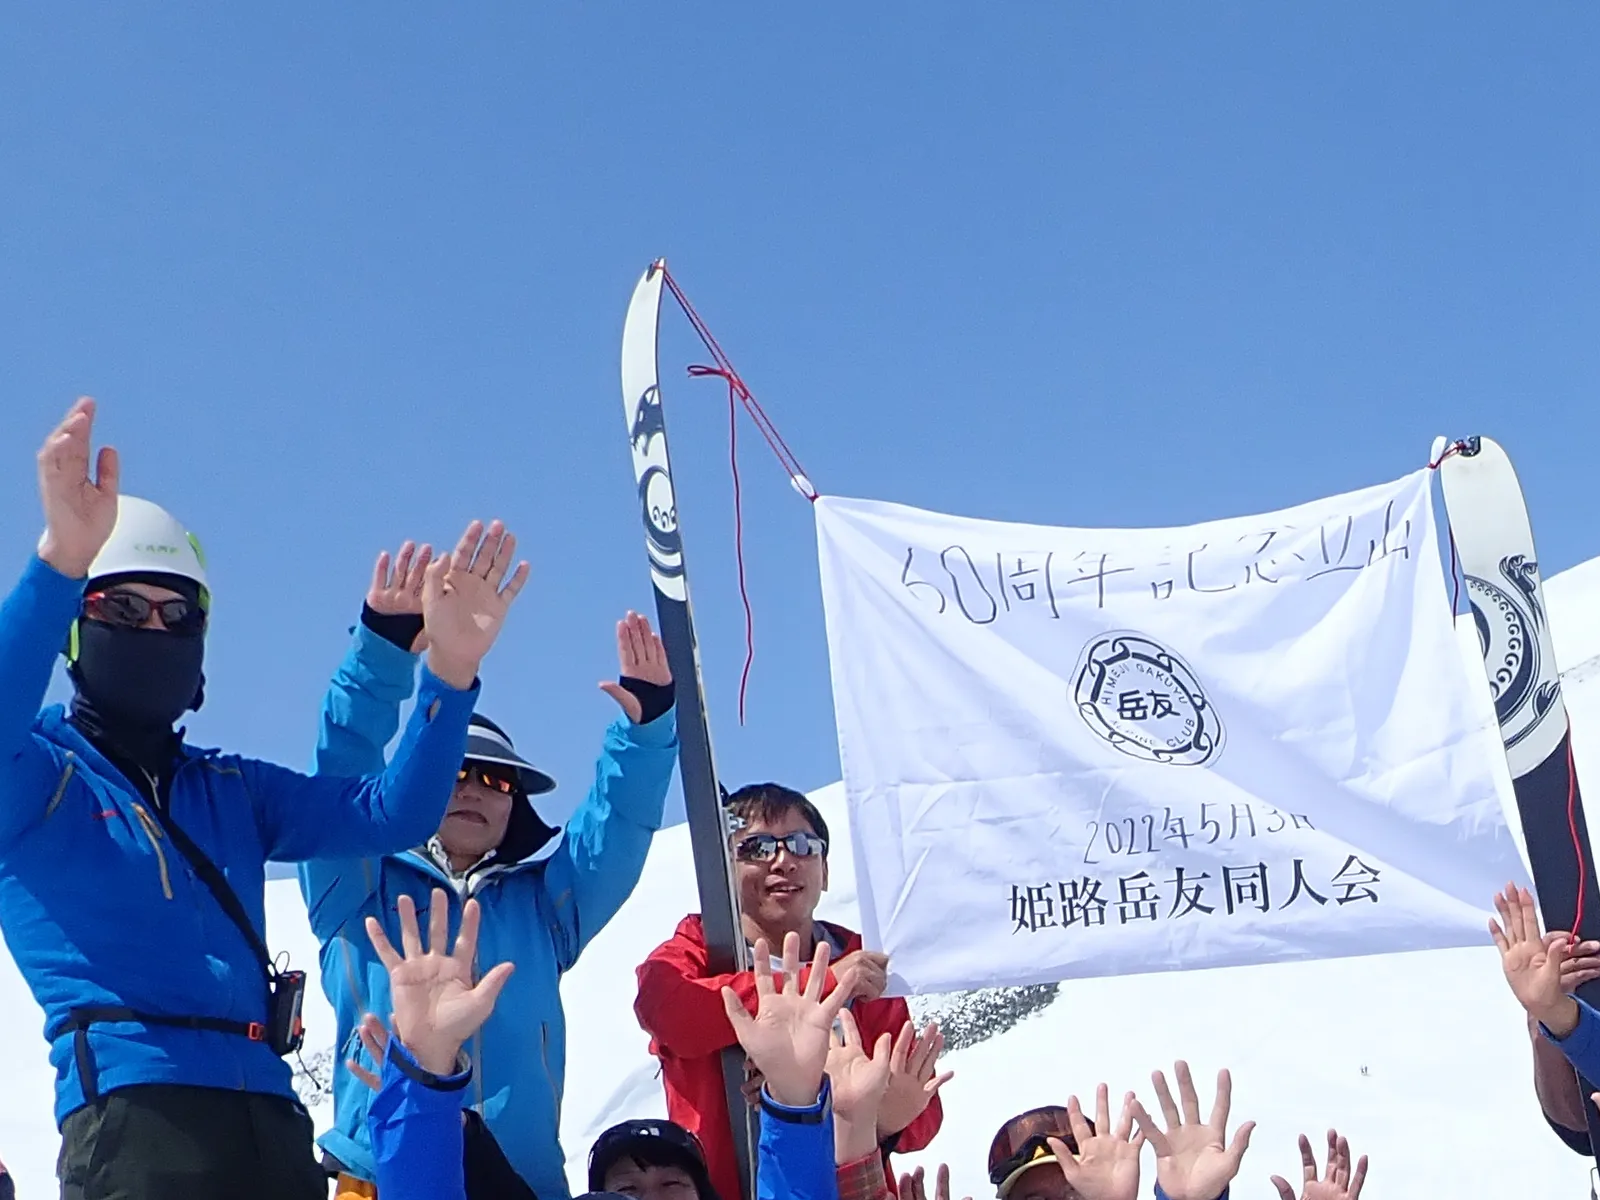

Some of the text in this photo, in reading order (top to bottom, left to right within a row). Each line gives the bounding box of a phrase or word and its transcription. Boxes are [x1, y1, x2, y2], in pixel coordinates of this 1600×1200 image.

[1136, 663, 1188, 705] GAKUYU
[1117, 689, 1180, 720] 岳友
[1166, 718, 1195, 747] CLUB
[1007, 854, 1382, 936] 姫路岳友同人会
